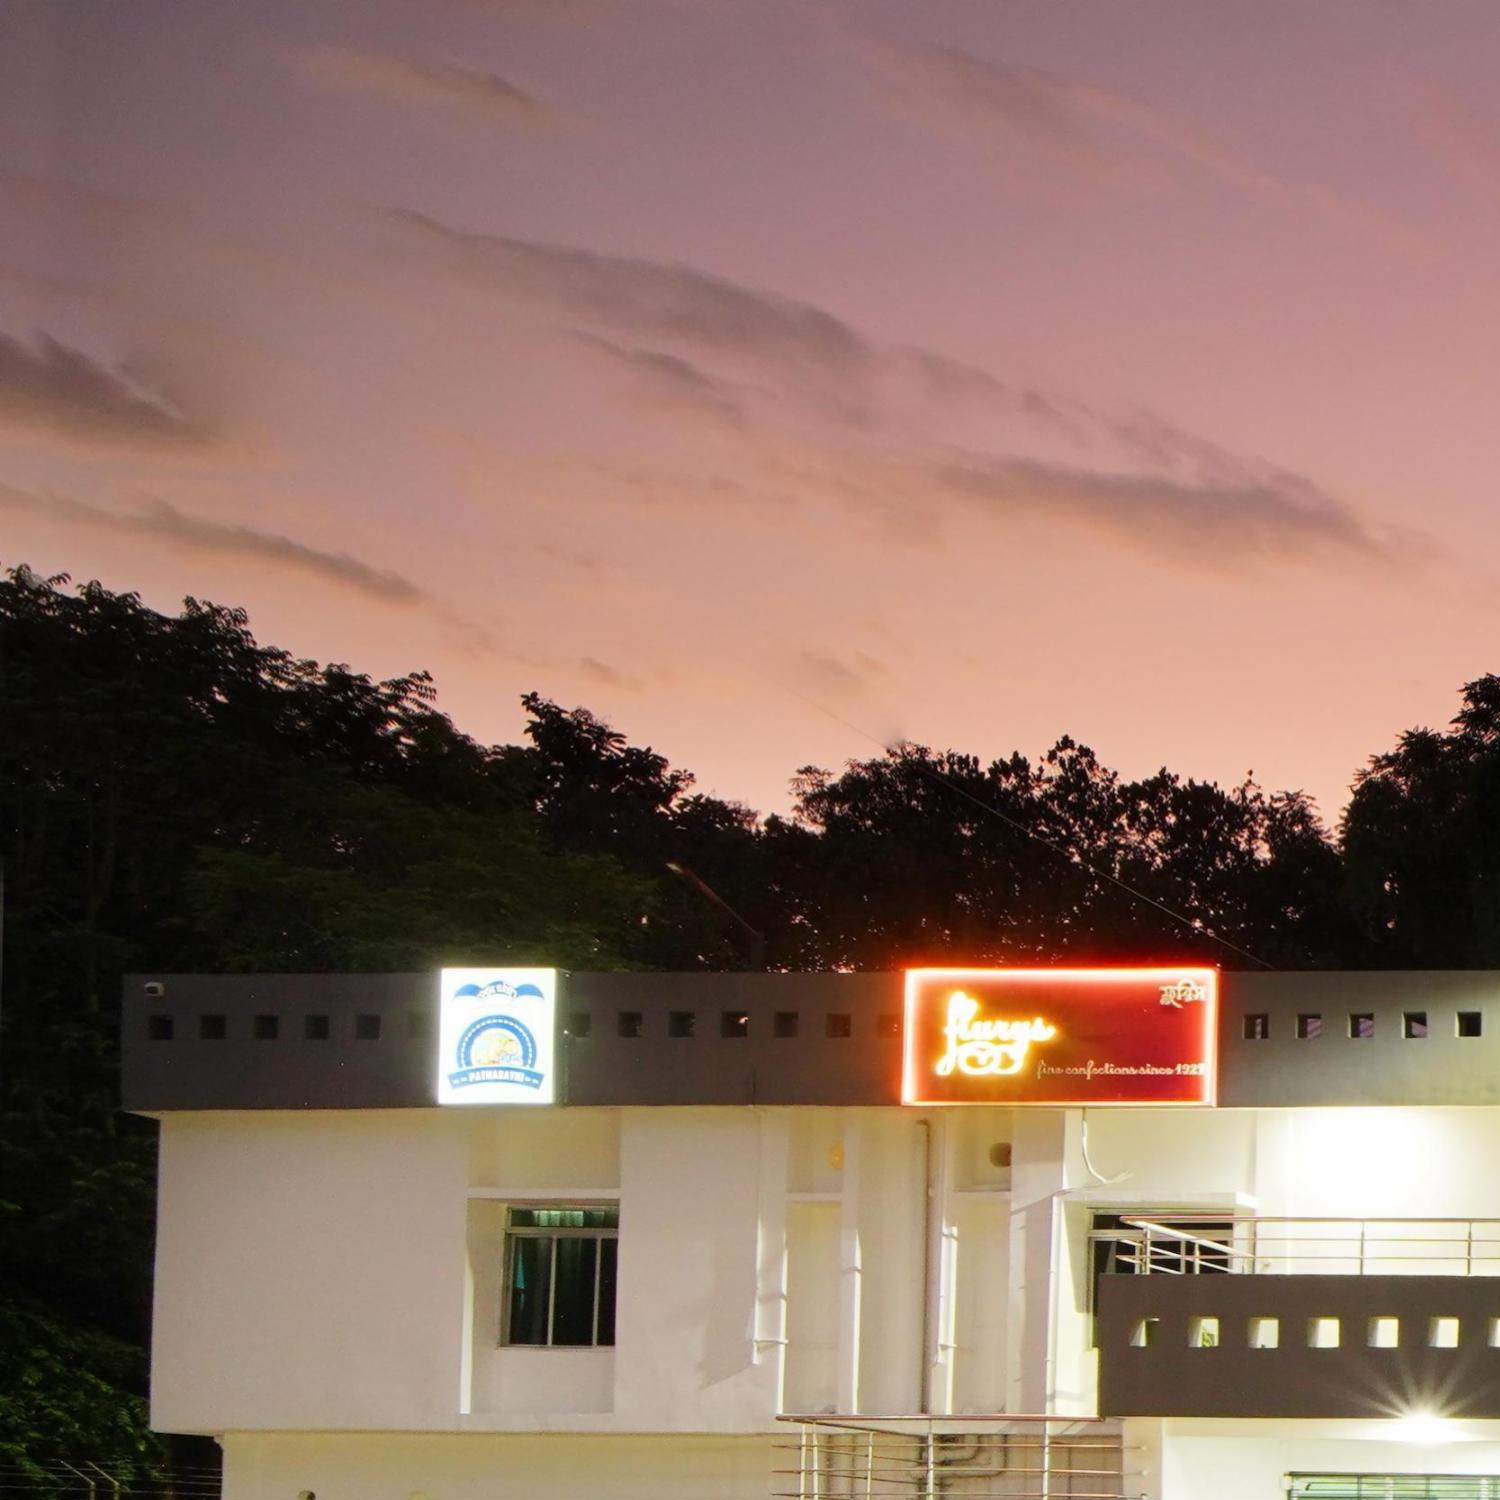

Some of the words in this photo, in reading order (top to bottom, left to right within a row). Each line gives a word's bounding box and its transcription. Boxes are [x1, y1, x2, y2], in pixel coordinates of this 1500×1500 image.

[1037, 1060, 1064, 1080] fine
[1065, 1059, 1138, 1080] confections
[1138, 1062, 1174, 1076] since
